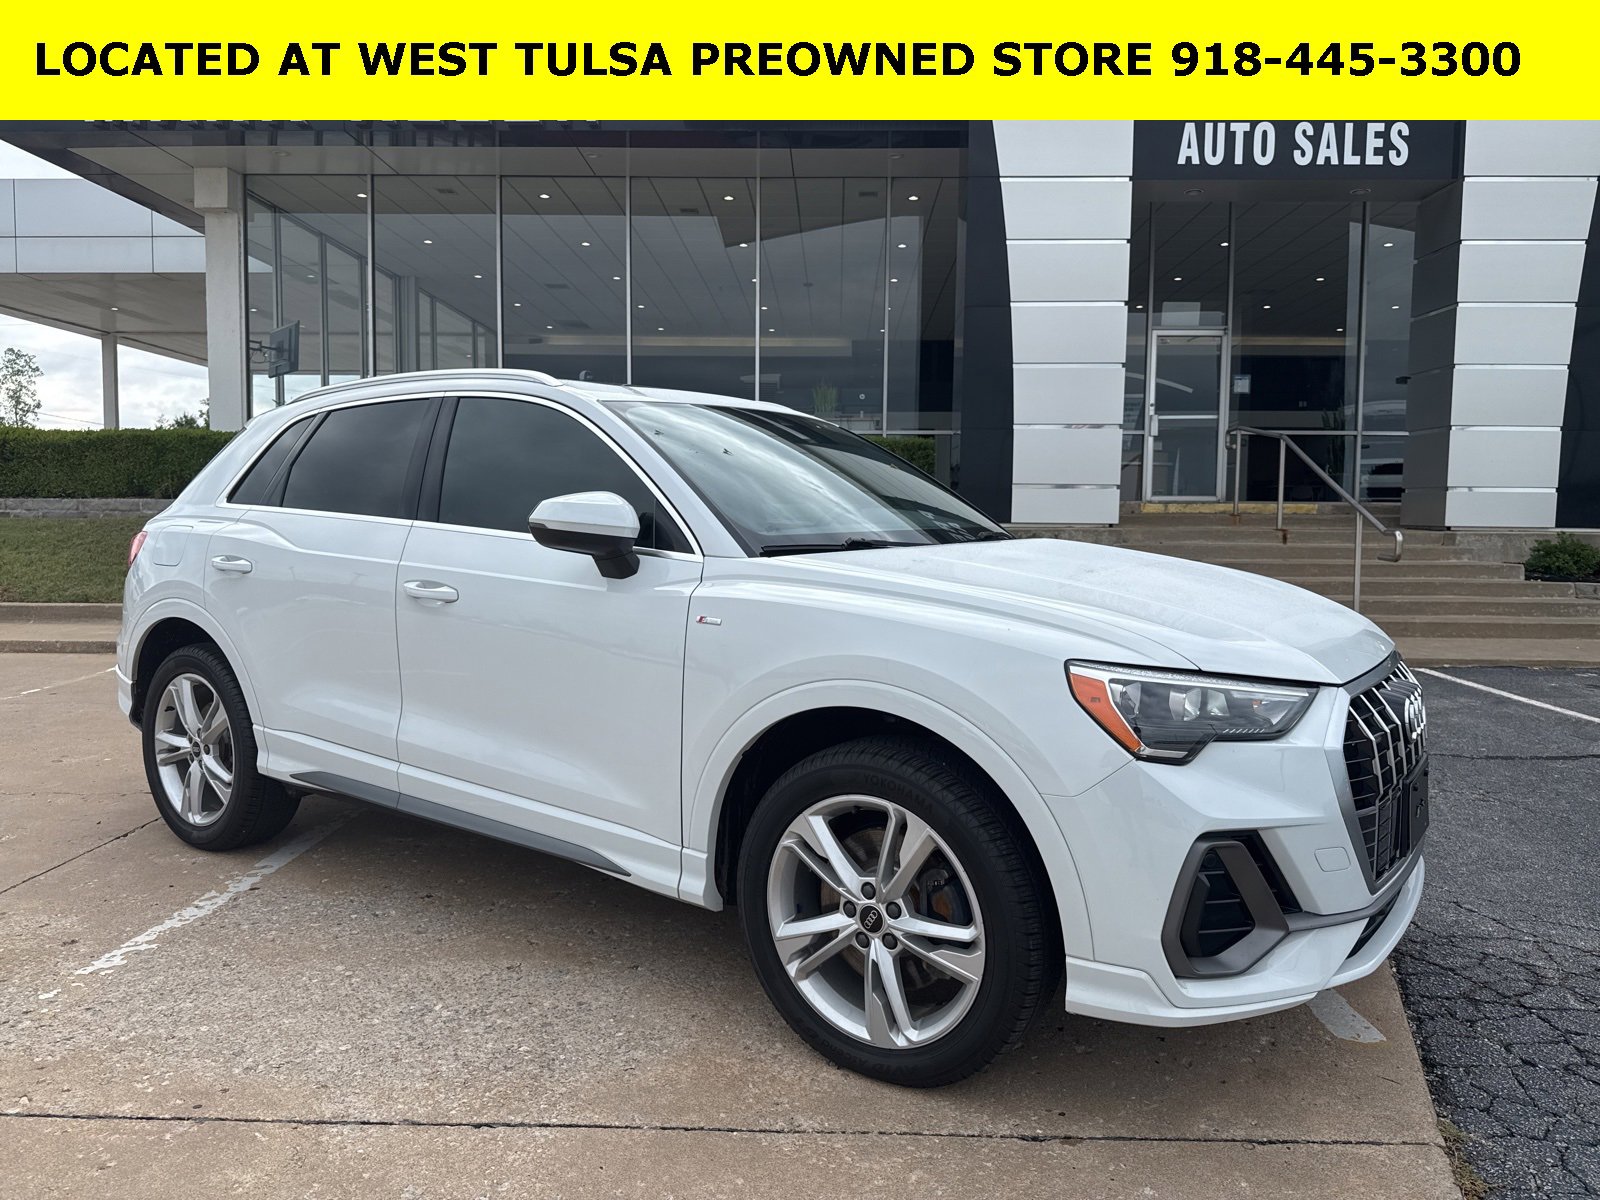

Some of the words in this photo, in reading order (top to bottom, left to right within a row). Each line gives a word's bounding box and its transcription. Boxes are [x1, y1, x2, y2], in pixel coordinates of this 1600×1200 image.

[1178, 122, 1276, 166] AUTO
[1294, 122, 1410, 166] SALES
[863, 773, 934, 815] YOKOHAMA
